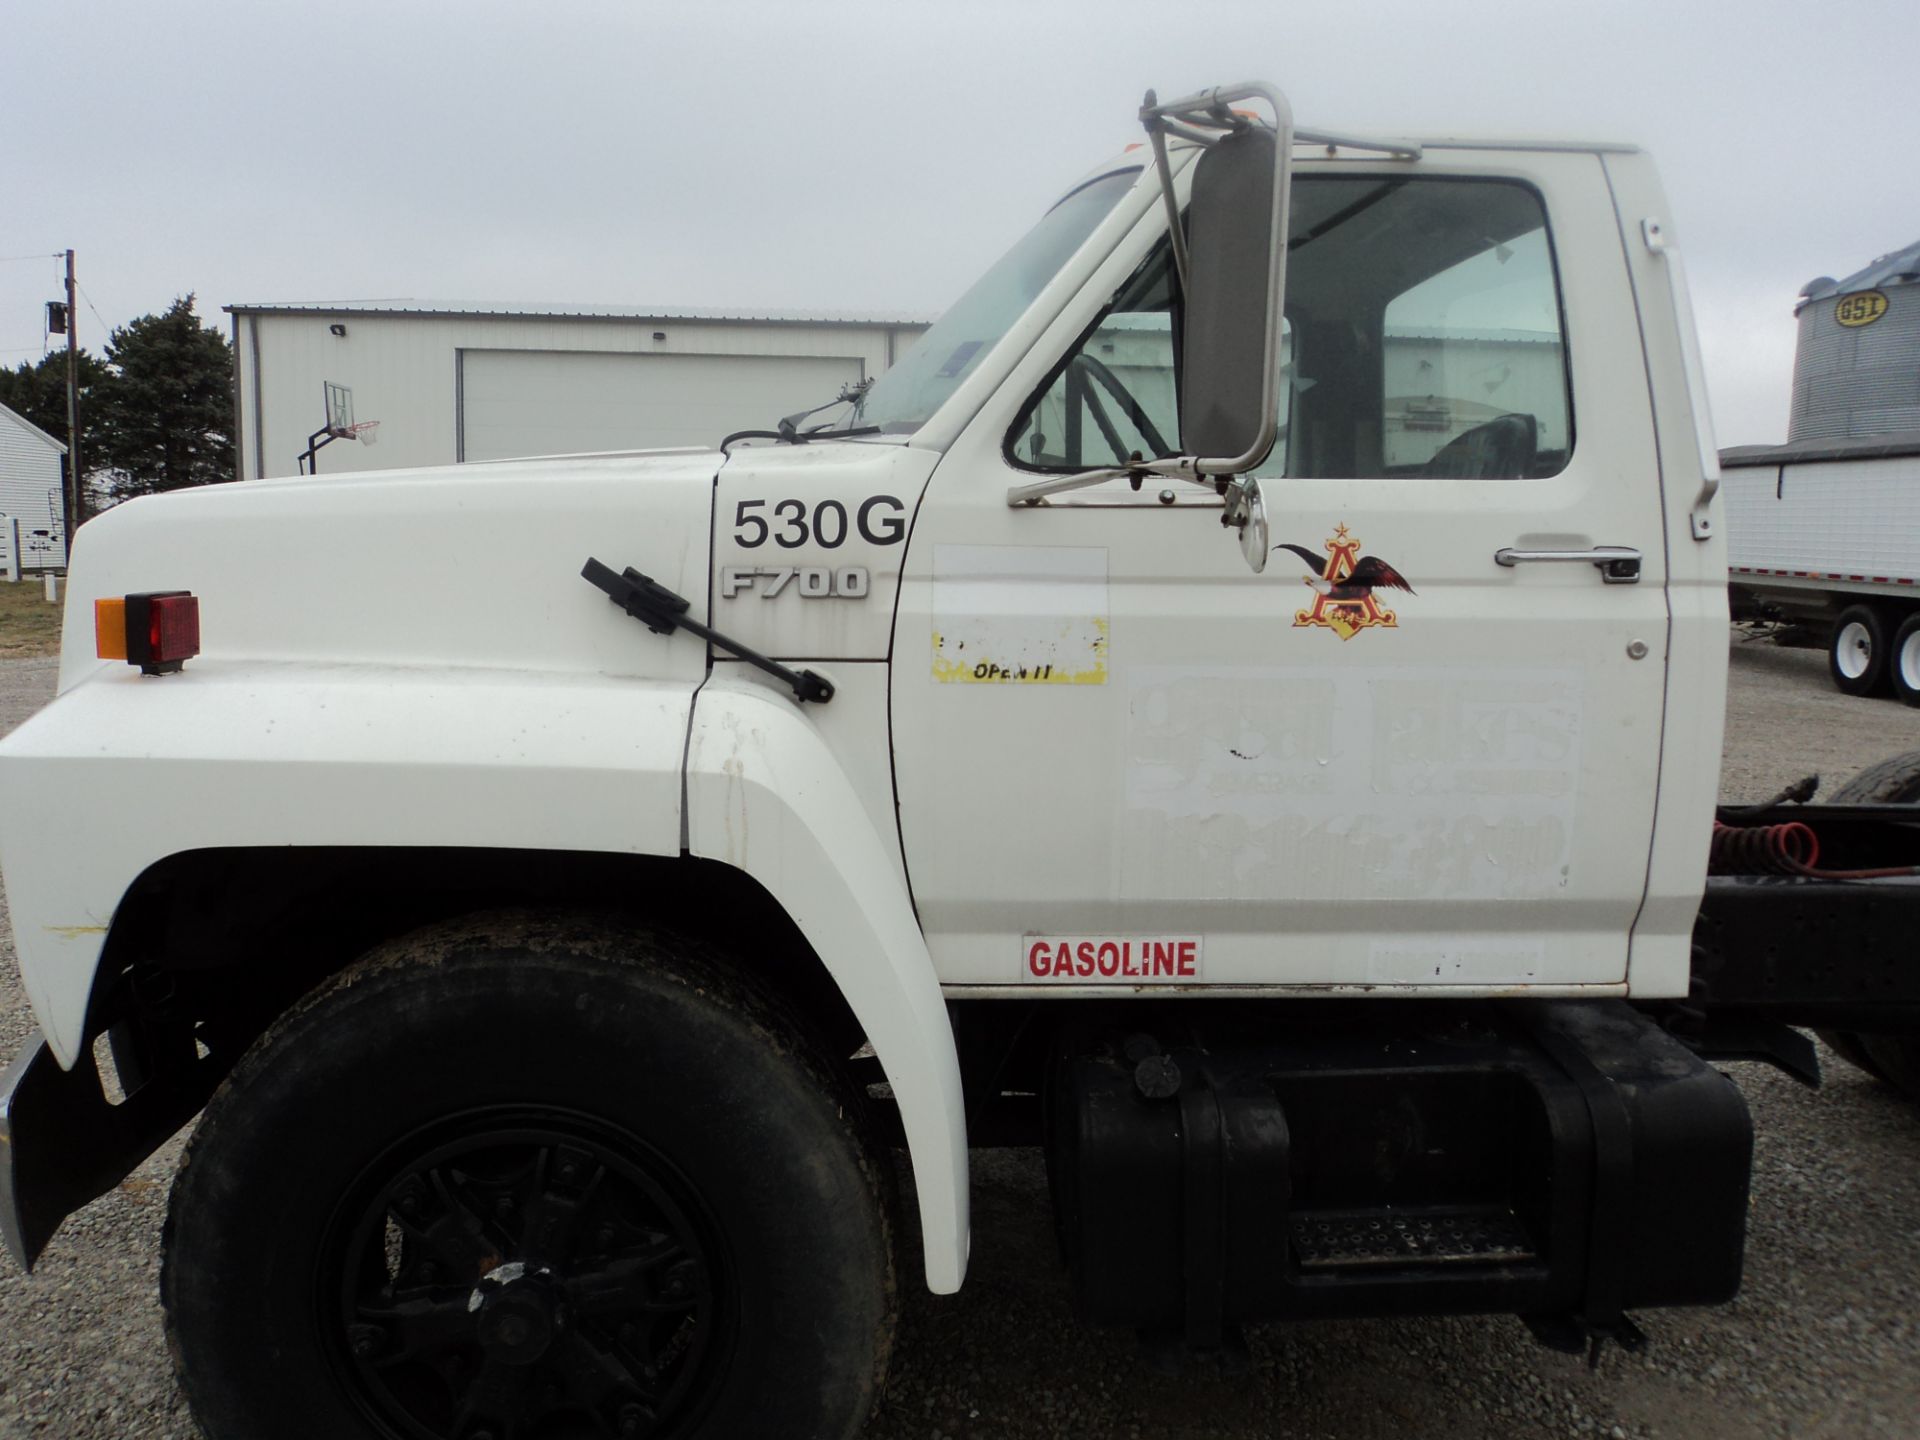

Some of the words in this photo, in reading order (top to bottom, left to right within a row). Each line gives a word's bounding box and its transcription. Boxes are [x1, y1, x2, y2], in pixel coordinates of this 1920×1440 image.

[1841, 297, 1880, 320] GSI
[722, 566, 870, 600] F700
[1029, 941, 1196, 977] GASOLINE
